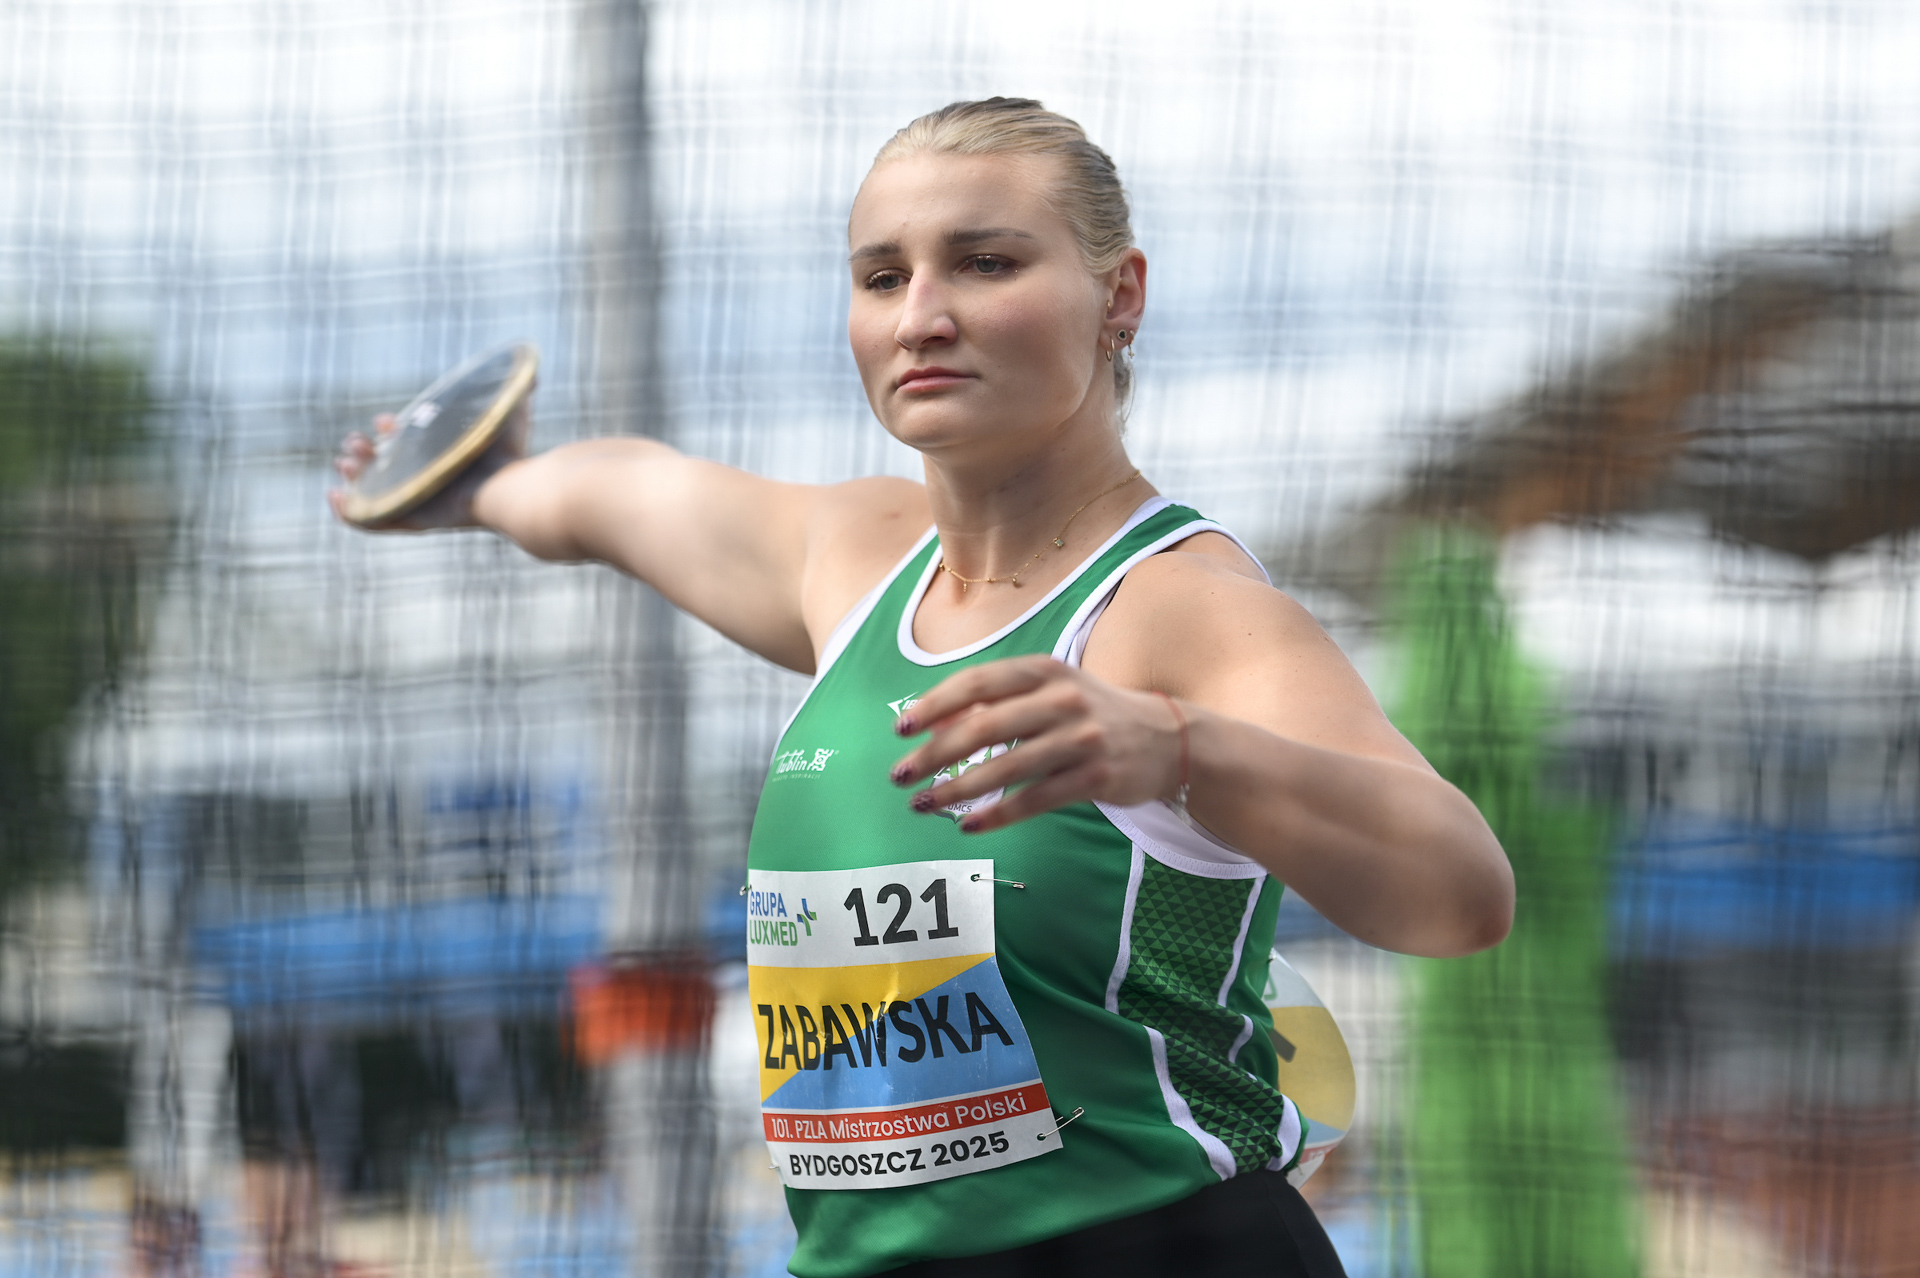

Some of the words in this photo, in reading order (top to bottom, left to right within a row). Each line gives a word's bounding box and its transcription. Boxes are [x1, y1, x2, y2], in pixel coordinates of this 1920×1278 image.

[750, 891, 788, 917] GRUPA
[843, 878, 959, 947] 121
[750, 920, 798, 946] LUXMED
[758, 991, 1014, 1071] ZABAWSKA
[771, 1118, 793, 1139] 101.
[795, 1120, 828, 1140] PZLA
[831, 1110, 950, 1140] Mistrzostwa
[954, 1092, 1027, 1125] Polski
[789, 1147, 926, 1176] BYDGOSZCZ
[930, 1130, 1010, 1167] 2025
